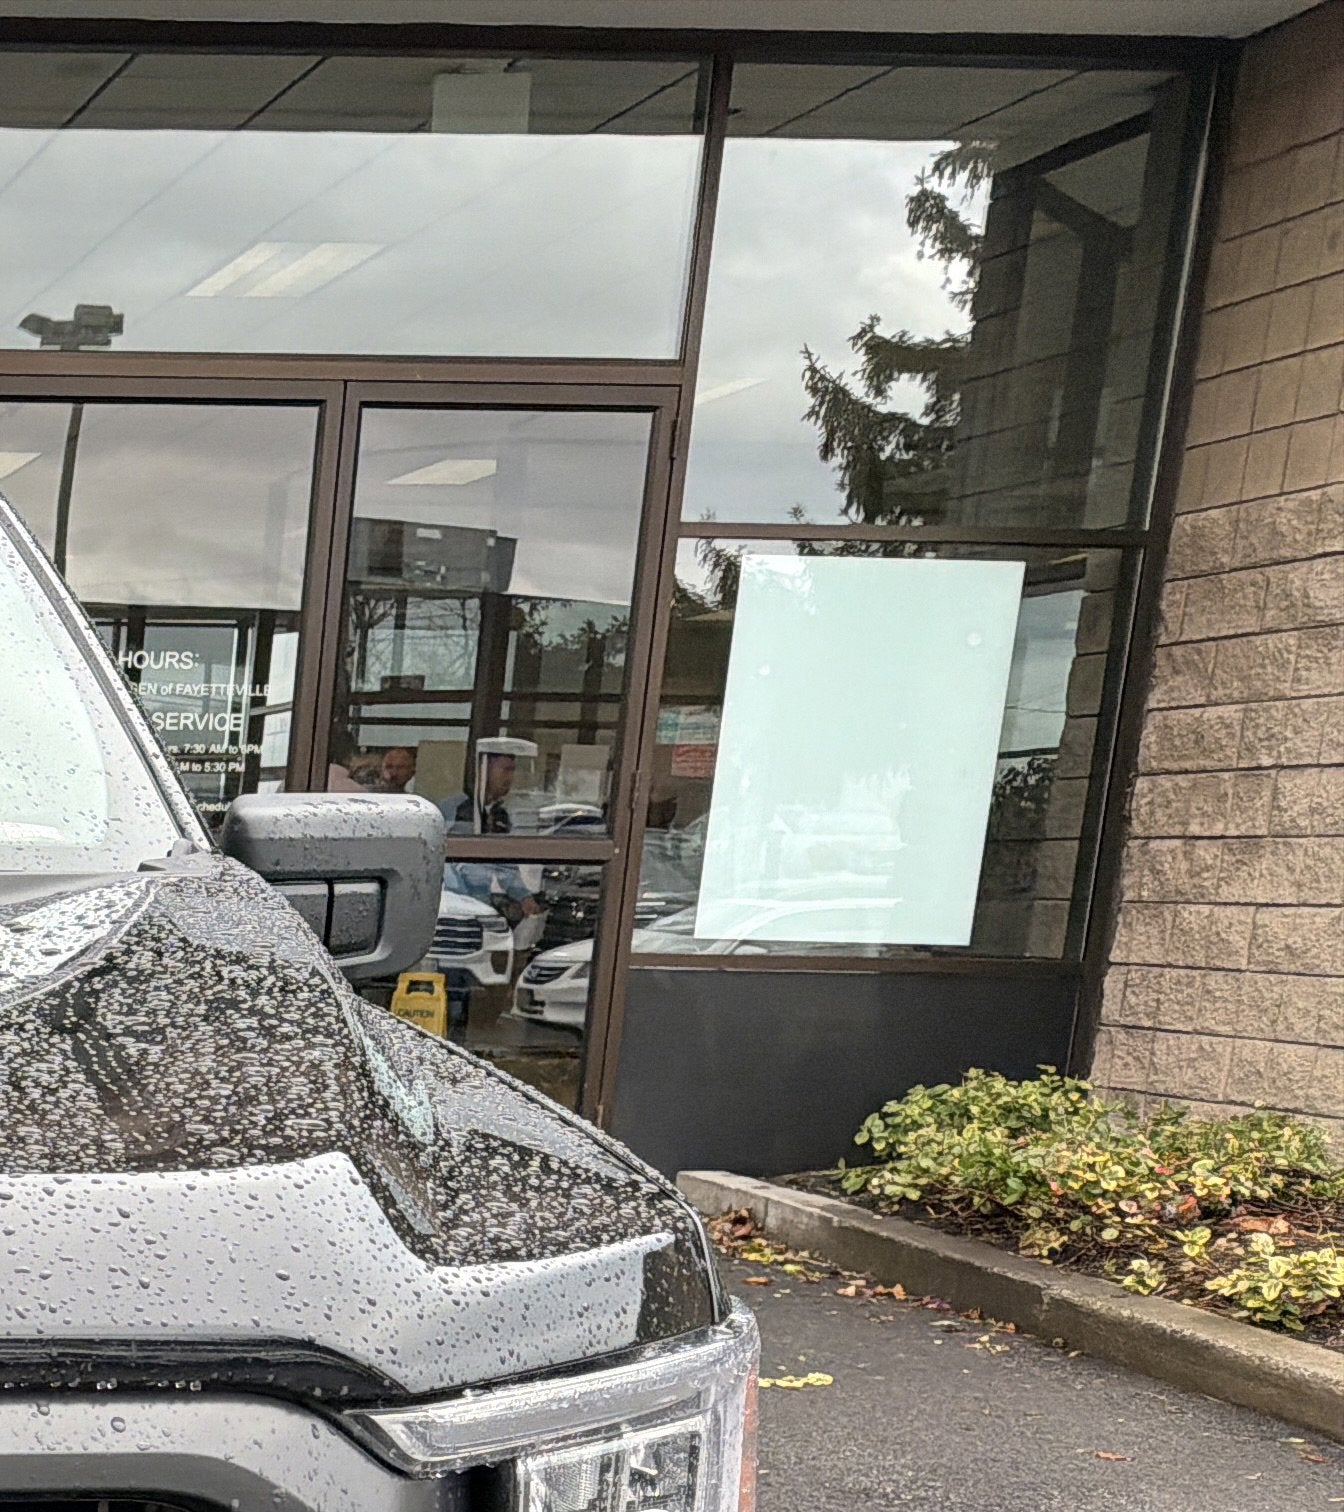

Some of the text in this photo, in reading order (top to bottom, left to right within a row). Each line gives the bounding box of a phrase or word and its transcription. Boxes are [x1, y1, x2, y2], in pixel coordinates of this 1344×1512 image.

[118, 650, 200, 670] HOURS:
[161, 683, 174, 696] of
[175, 683, 271, 697] FAYETTEVILLE
[151, 712, 244, 732] SERVICE
[184, 743, 206, 754] 7:30
[208, 743, 226, 754] AM
[229, 743, 239, 755] to
[192, 761, 202, 772] to
[204, 761, 226, 773] 5:30
[227, 761, 246, 773] PM
[397, 1007, 435, 1018] CAUTION
